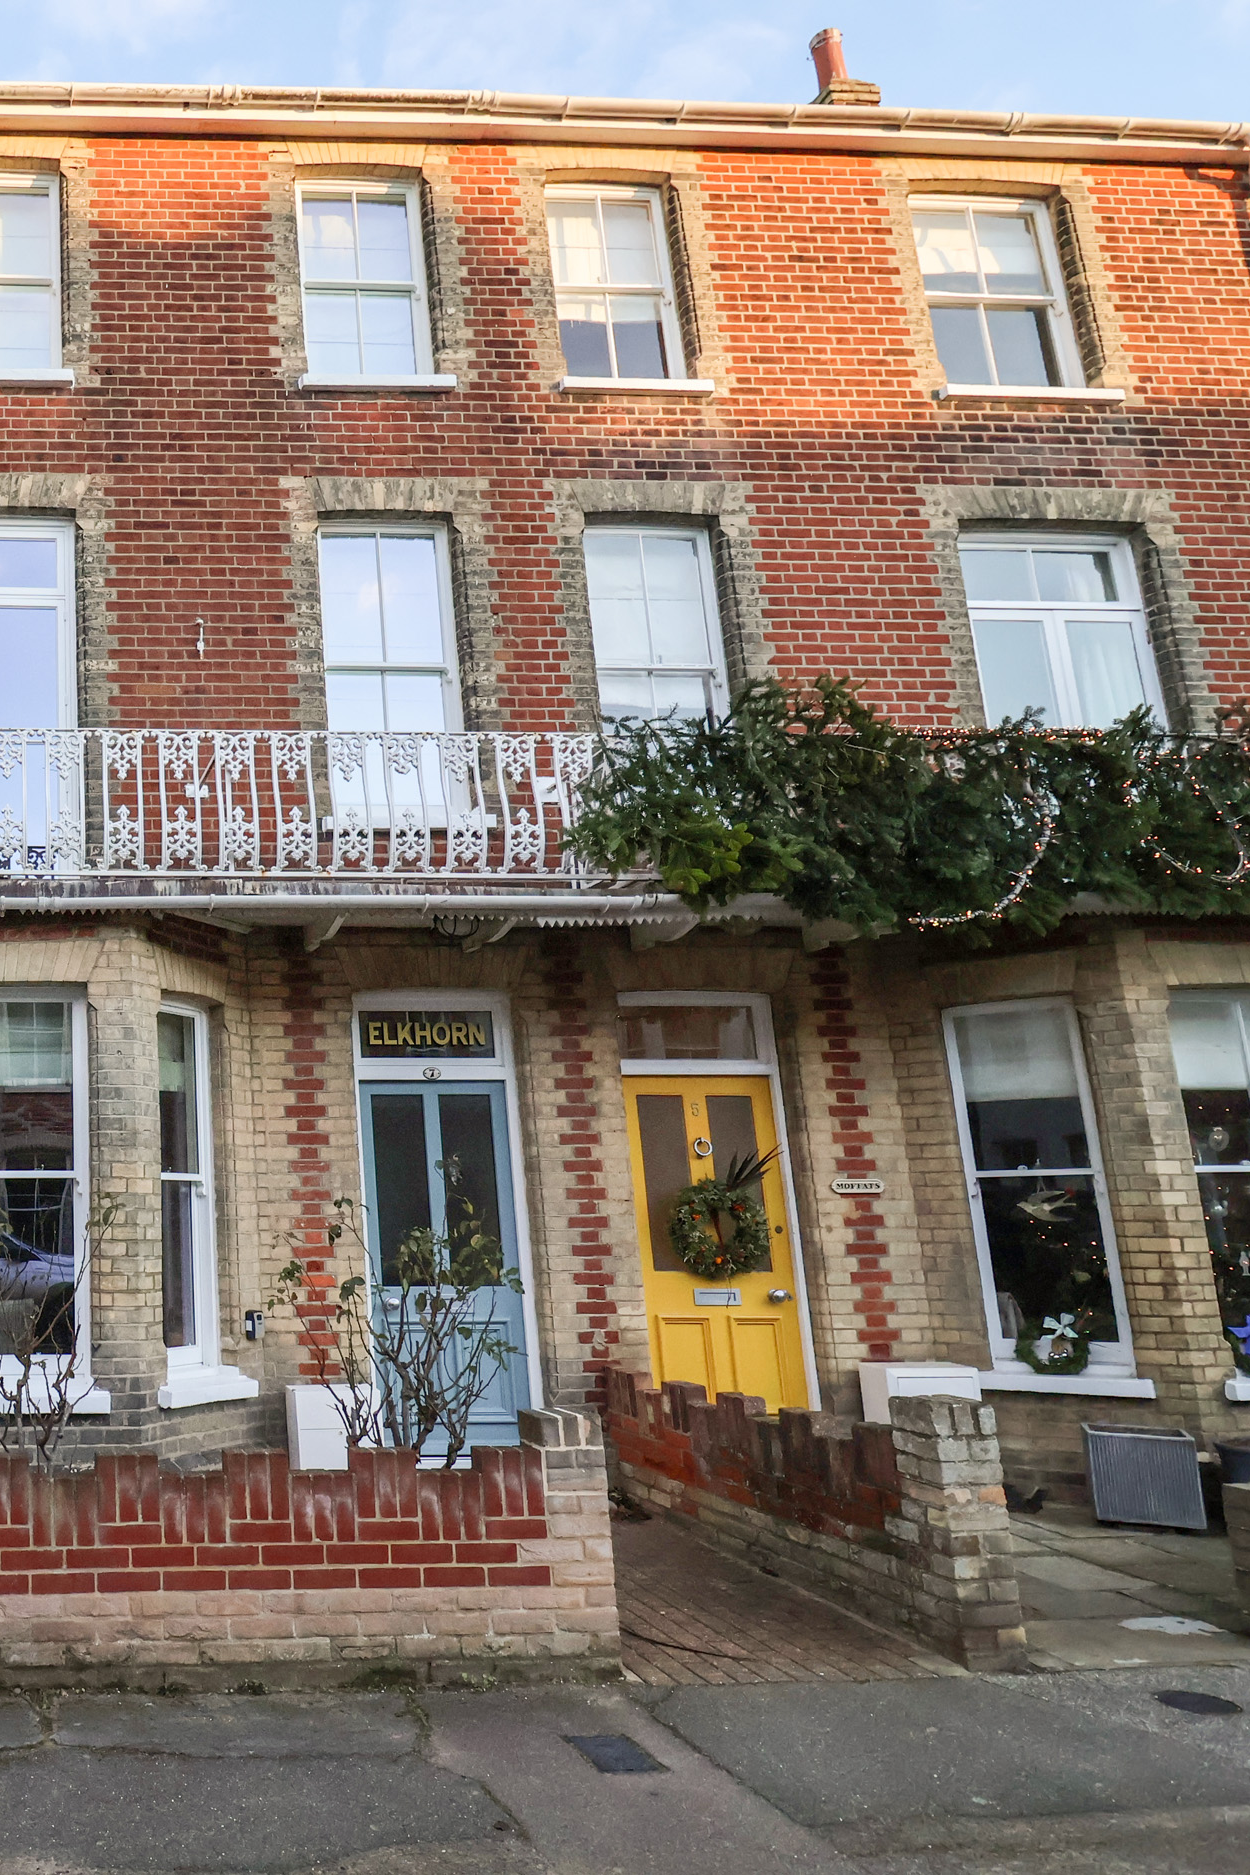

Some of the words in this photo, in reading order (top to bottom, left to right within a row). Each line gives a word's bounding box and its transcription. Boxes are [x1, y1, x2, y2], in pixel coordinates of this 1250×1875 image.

[368, 1021, 486, 1046] ELKHORN
[429, 1068, 435, 1078] 7
[691, 1103, 699, 1117] 5
